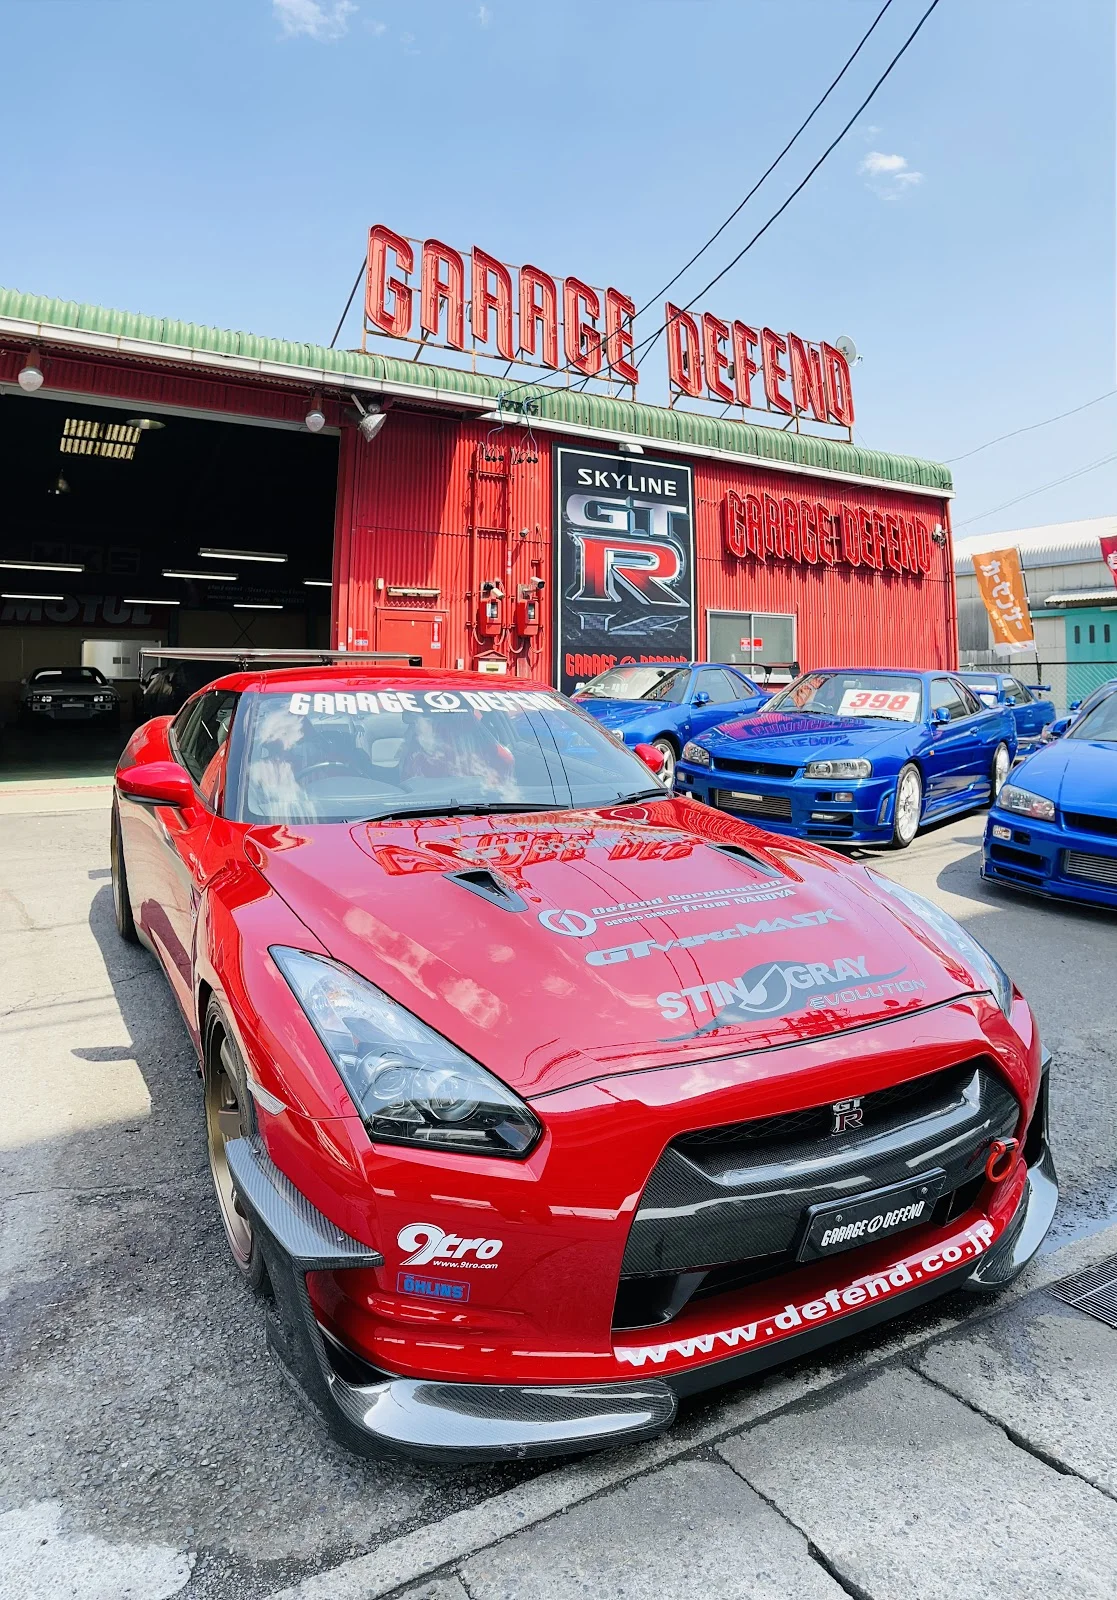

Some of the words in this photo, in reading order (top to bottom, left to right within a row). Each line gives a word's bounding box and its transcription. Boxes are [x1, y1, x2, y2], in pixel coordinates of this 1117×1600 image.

[365, 223, 639, 385] GARAGE
[665, 301, 855, 427] DEFEND
[577, 468, 677, 496] SKYLINE
[566, 493, 689, 538] GT
[722, 489, 834, 567] GARAGE
[840, 501, 932, 575] DEFEND
[565, 529, 690, 608] R
[0, 594, 153, 625] MOTUL
[289, 692, 424, 715] GARAGE
[460, 691, 567, 712] DEFEND
[849, 692, 910, 711] 398
[591, 897, 664, 915] Defend
[667, 879, 782, 902] Corporation
[682, 900, 731, 913] from
[808, 977, 929, 1010] EVOLUTION
[832, 1096, 865, 1112] GT
[830, 1108, 864, 1136] R
[820, 1220, 868, 1247] GARAGE
[883, 1201, 925, 1229] DEFEND
[397, 1222, 503, 1265] 9tro
[433, 1260, 498, 1270] www.9tro.com
[403, 1275, 465, 1299] ÖHLINS
[620, 1223, 995, 1367] www.defend.co.jp
